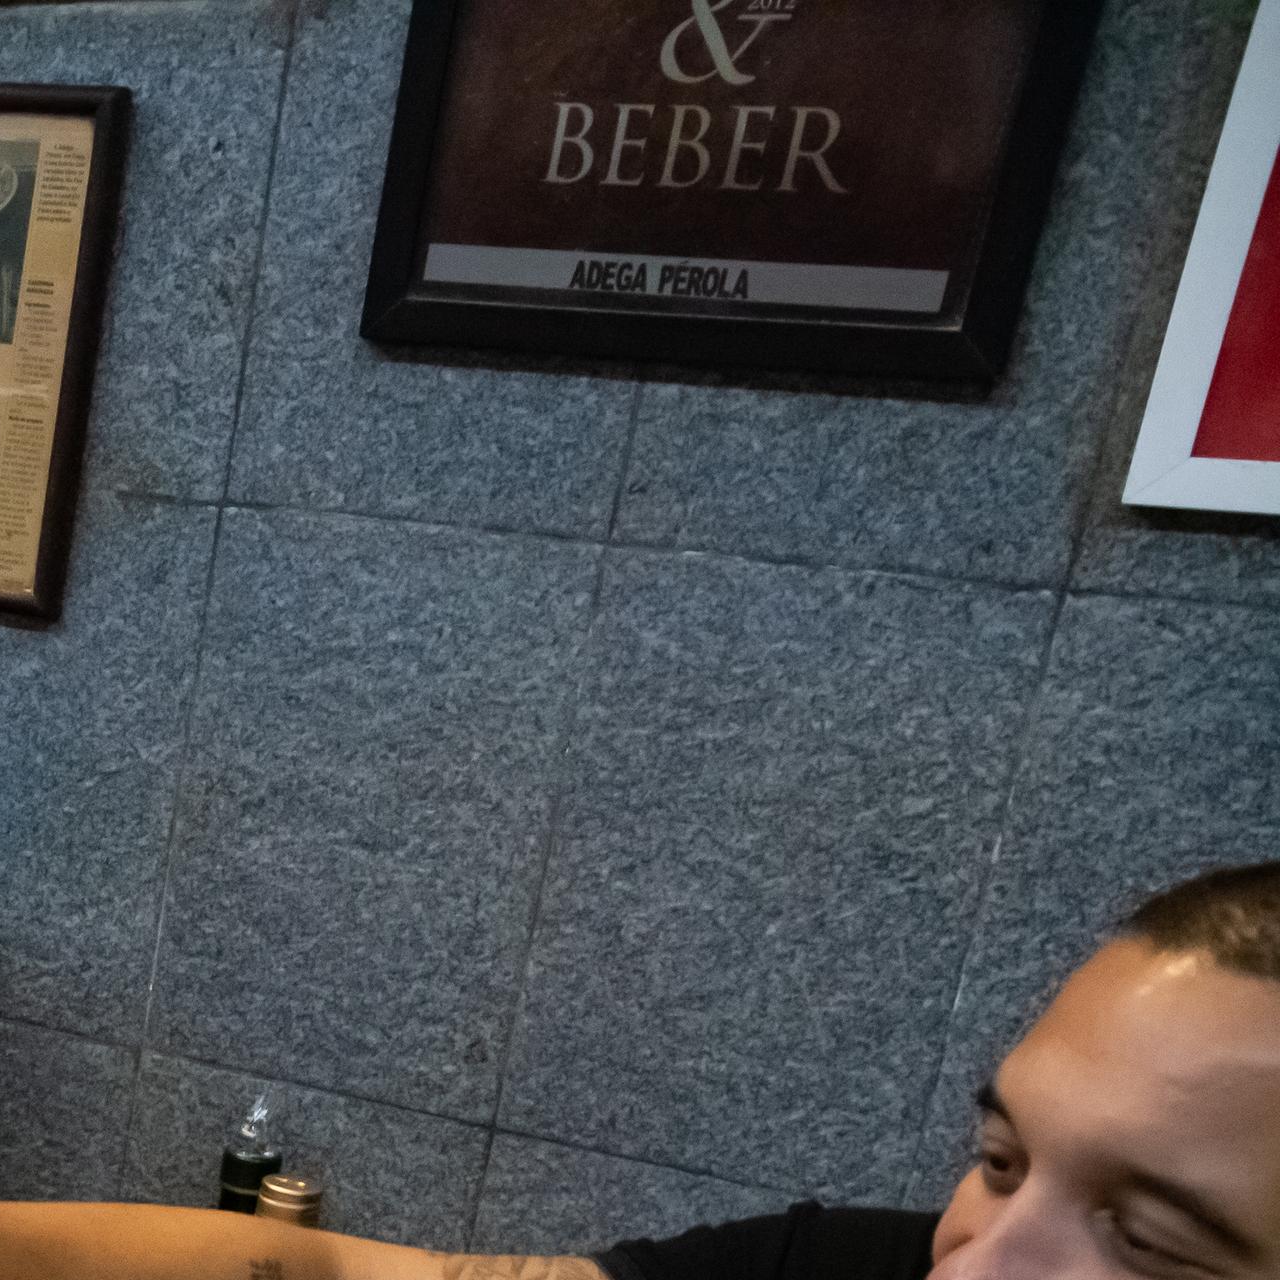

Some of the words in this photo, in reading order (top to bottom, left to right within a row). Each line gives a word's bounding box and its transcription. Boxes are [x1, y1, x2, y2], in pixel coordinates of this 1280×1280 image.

[541, 101, 848, 194] BEBER
[570, 259, 648, 293] ADEGA
[658, 260, 749, 299] PÉROLA
